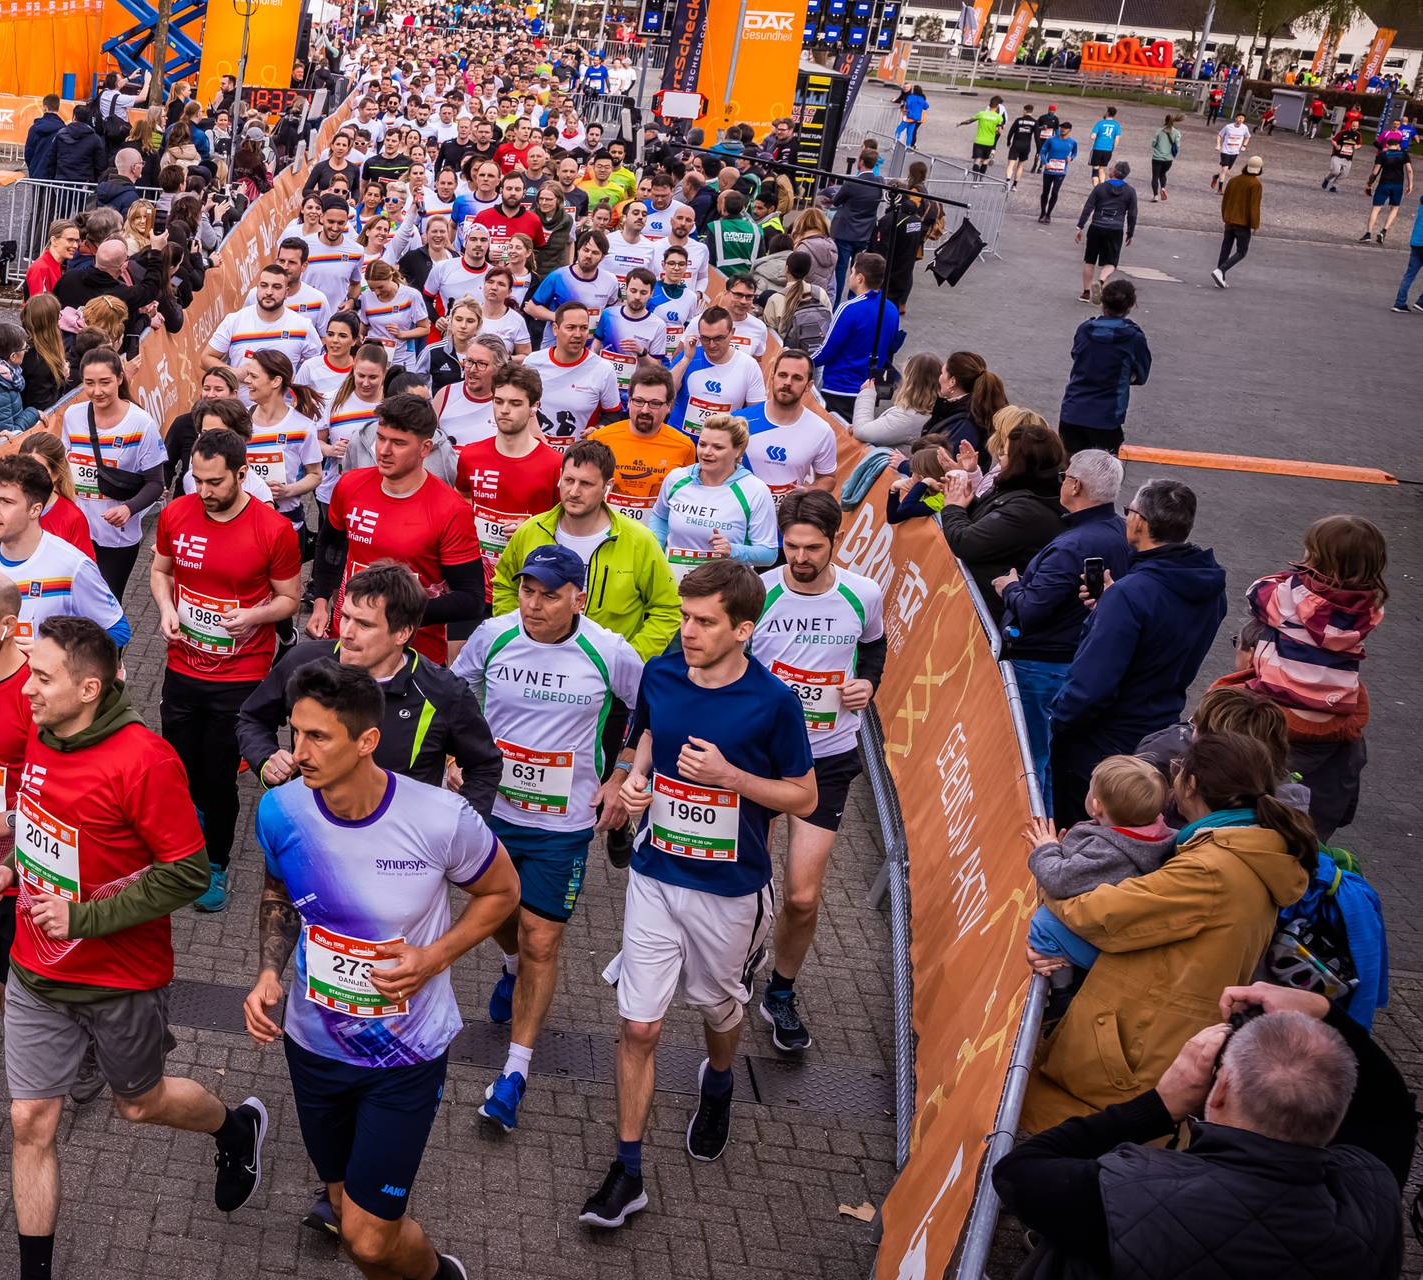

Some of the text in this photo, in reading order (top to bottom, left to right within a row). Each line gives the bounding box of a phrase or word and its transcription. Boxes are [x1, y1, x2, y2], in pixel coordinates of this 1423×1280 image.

[743, 10, 795, 31] DAK
[742, 29, 793, 41] Gesundheit
[473, 489, 498, 500] Trianel
[685, 516, 733, 531] EMBEDDED
[348, 529, 373, 545] Trianel
[175, 556, 203, 570] Trianel
[188, 606, 222, 627] 1989
[767, 618, 837, 633] AVNET
[794, 633, 856, 645] EMBEDDED
[496, 665, 570, 689] AVNET
[522, 687, 592, 706] EMBEDDED
[789, 683, 823, 701] 633
[512, 763, 546, 783] 631
[520, 780, 537, 788] THEO
[668, 800, 717, 825] 1960
[26, 823, 61, 860] 2014
[376, 858, 427, 871] SYNOPSYS
[332, 955, 374, 980] 273
[328, 988, 355, 1000] STARTZEIT
[380, 1183, 407, 1198] JAKO
